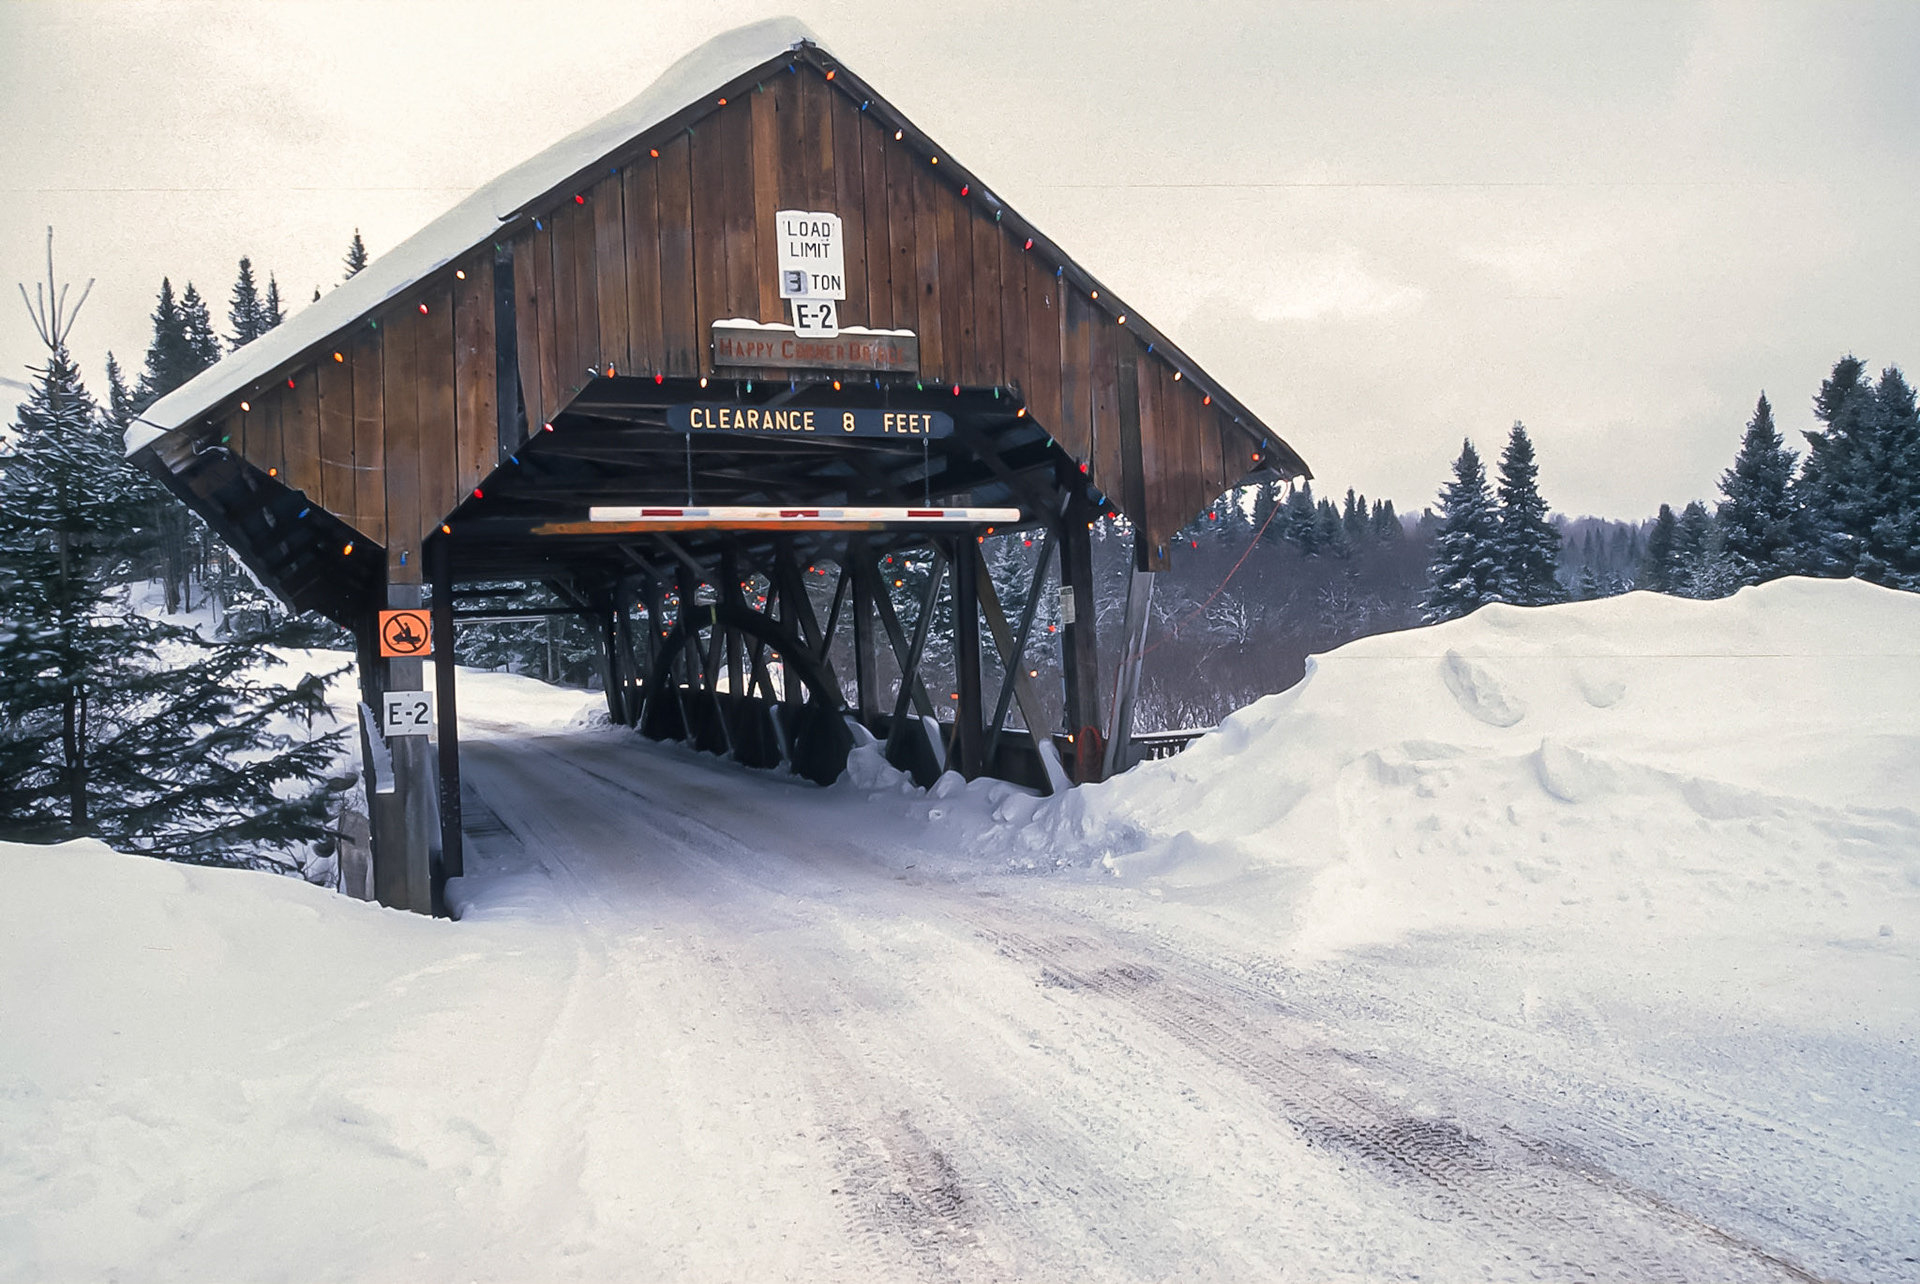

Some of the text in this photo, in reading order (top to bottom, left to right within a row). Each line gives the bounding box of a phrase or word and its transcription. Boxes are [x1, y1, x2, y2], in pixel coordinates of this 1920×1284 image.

[788, 220, 831, 238] LOAD
[790, 241, 831, 259] LIMIT
[789, 270, 841, 292] 3 TON
[796, 304, 834, 329] E-2
[719, 337, 774, 359] HAPPY
[690, 408, 932, 434] CLEARANCE 8 FEET
[389, 701, 429, 726] E-2
